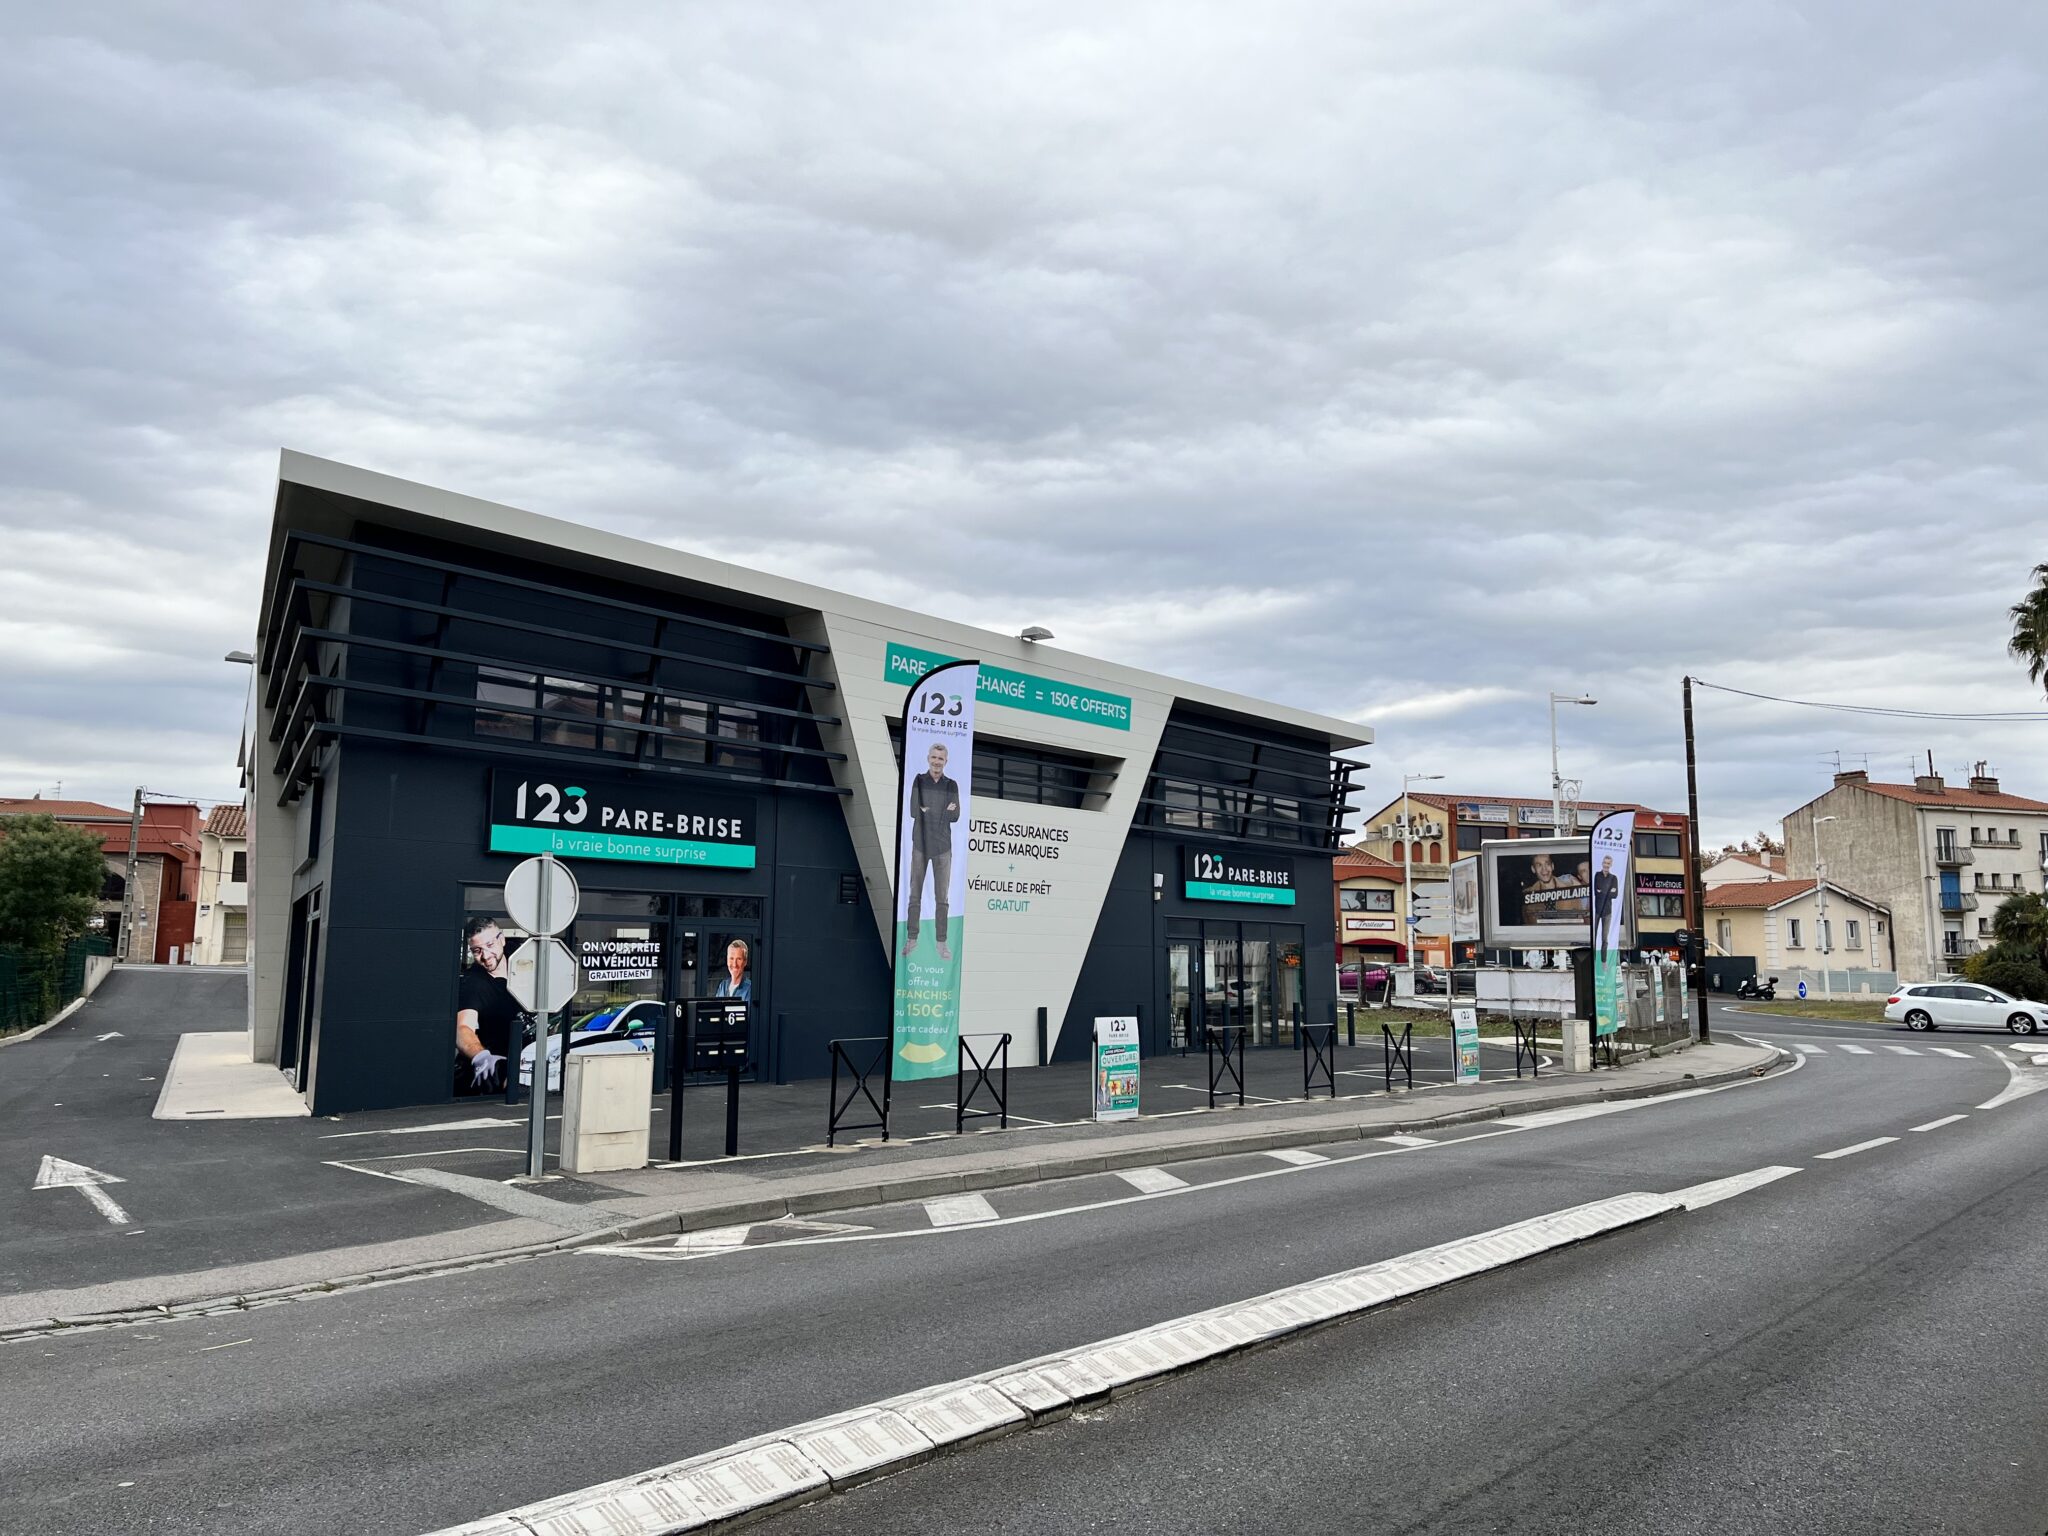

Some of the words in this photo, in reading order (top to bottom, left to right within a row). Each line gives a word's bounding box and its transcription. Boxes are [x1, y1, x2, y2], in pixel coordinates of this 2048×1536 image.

[891, 654, 939, 676] PARE-
[1051, 691, 1078, 710] 150€
[1081, 697, 1127, 720] OFFERTS
[920, 691, 962, 716] 123
[912, 715, 968, 730] PARE-BRISE
[516, 781, 588, 825] 123
[601, 806, 742, 839] PARE-BRISE
[969, 819, 997, 835] UTES
[1000, 823, 1069, 842] ASSURANCES
[1598, 827, 1623, 841] 123
[552, 832, 564, 850] la
[568, 835, 602, 853] vraie
[607, 837, 650, 857] bonne
[655, 843, 707, 864] surprise
[968, 838, 1005, 854] OUTES
[1008, 843, 1059, 860] MARQUES
[1194, 853, 1223, 880] 123
[1228, 867, 1289, 885] PARE-BRISE
[968, 874, 1013, 893] VÉHICULE
[1016, 882, 1028, 894] DE
[1030, 879, 1051, 895] PRÊT
[1209, 883, 1216, 896] la
[1232, 886, 1251, 898] bonne
[988, 898, 1030, 912] GRATUIT
[582, 941, 599, 952] ON
[601, 942, 630, 953] VOUS
[631, 940, 660, 953] PRÊTE
[582, 956, 600, 968] UN
[602, 953, 658, 968] VÉHICULE
[907, 962, 921, 973] On
[590, 970, 650, 980] GRATUITEMENT
[908, 976, 929, 986] offre
[932, 977, 939, 987] la
[896, 988, 953, 1001] FRANCHISE
[676, 1004, 682, 1017] 6
[907, 1003, 943, 1018] 150€
[728, 1012, 735, 1025] 6
[1110, 1020, 1126, 1032] 123
